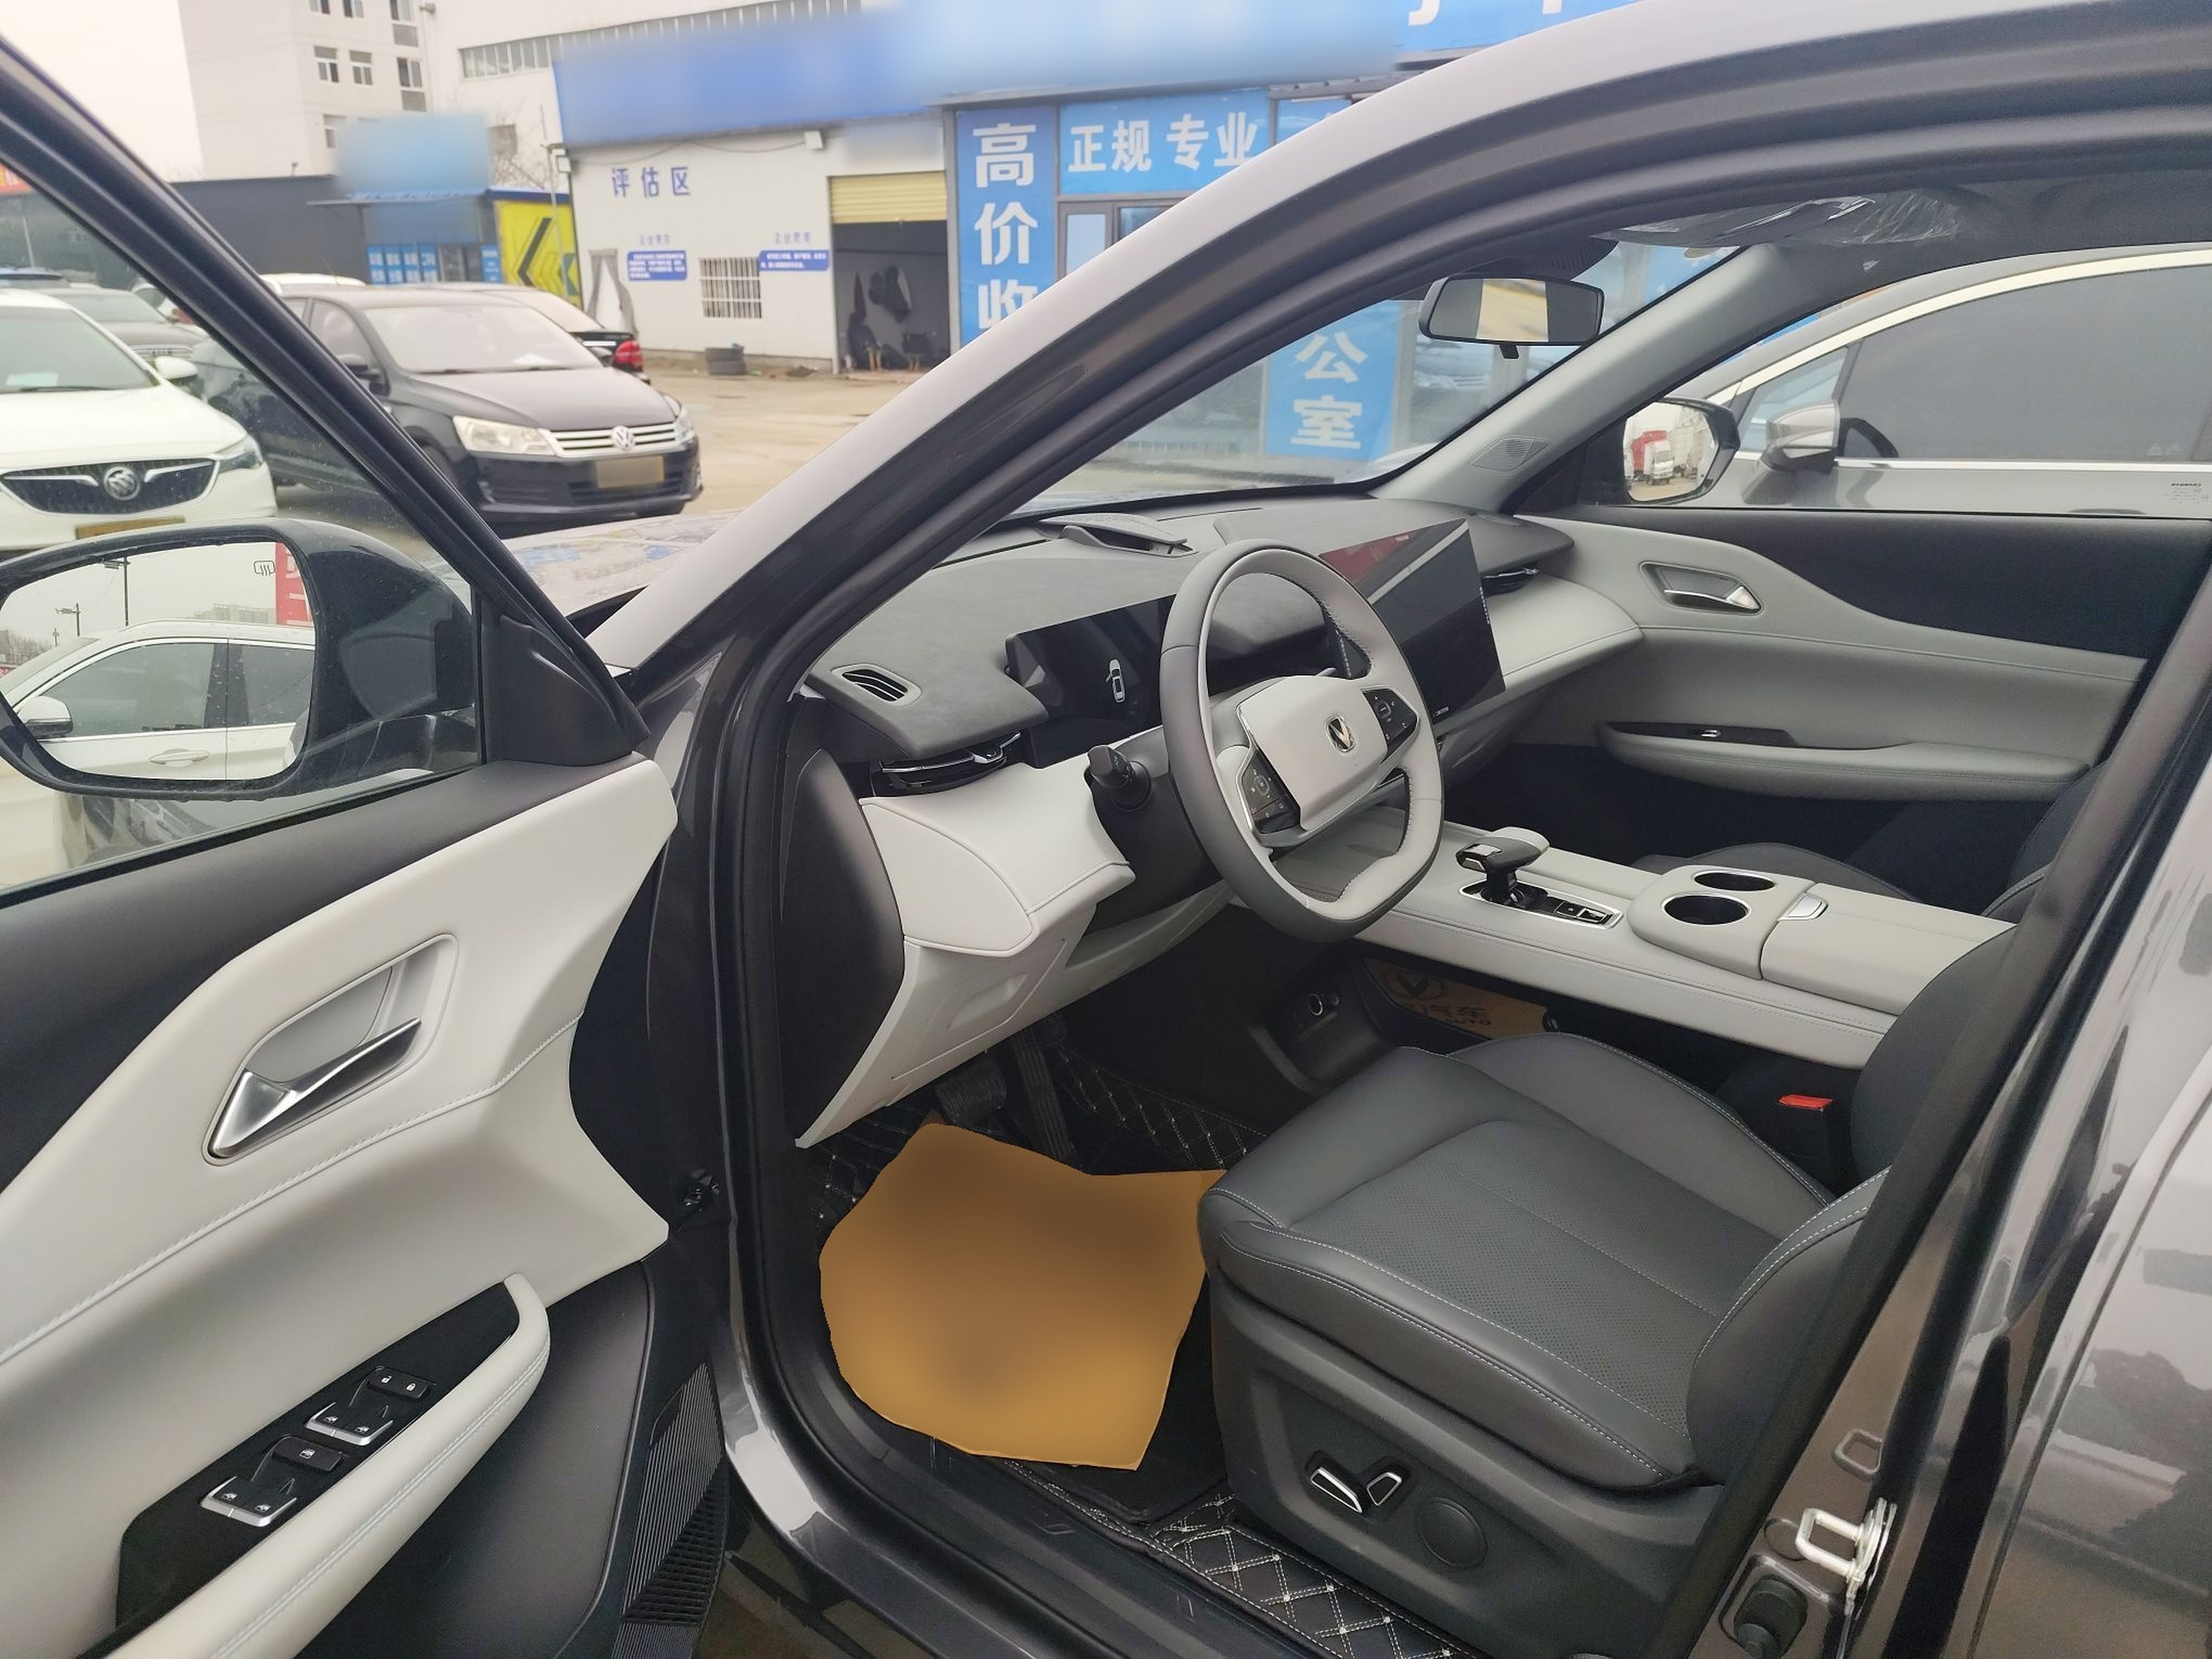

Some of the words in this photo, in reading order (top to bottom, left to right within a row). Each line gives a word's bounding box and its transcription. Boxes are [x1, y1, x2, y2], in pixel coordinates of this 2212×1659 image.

[1068, 119, 1152, 173] 正规
[1166, 112, 1259, 171] 专业
[611, 166, 691, 198] 评估区
